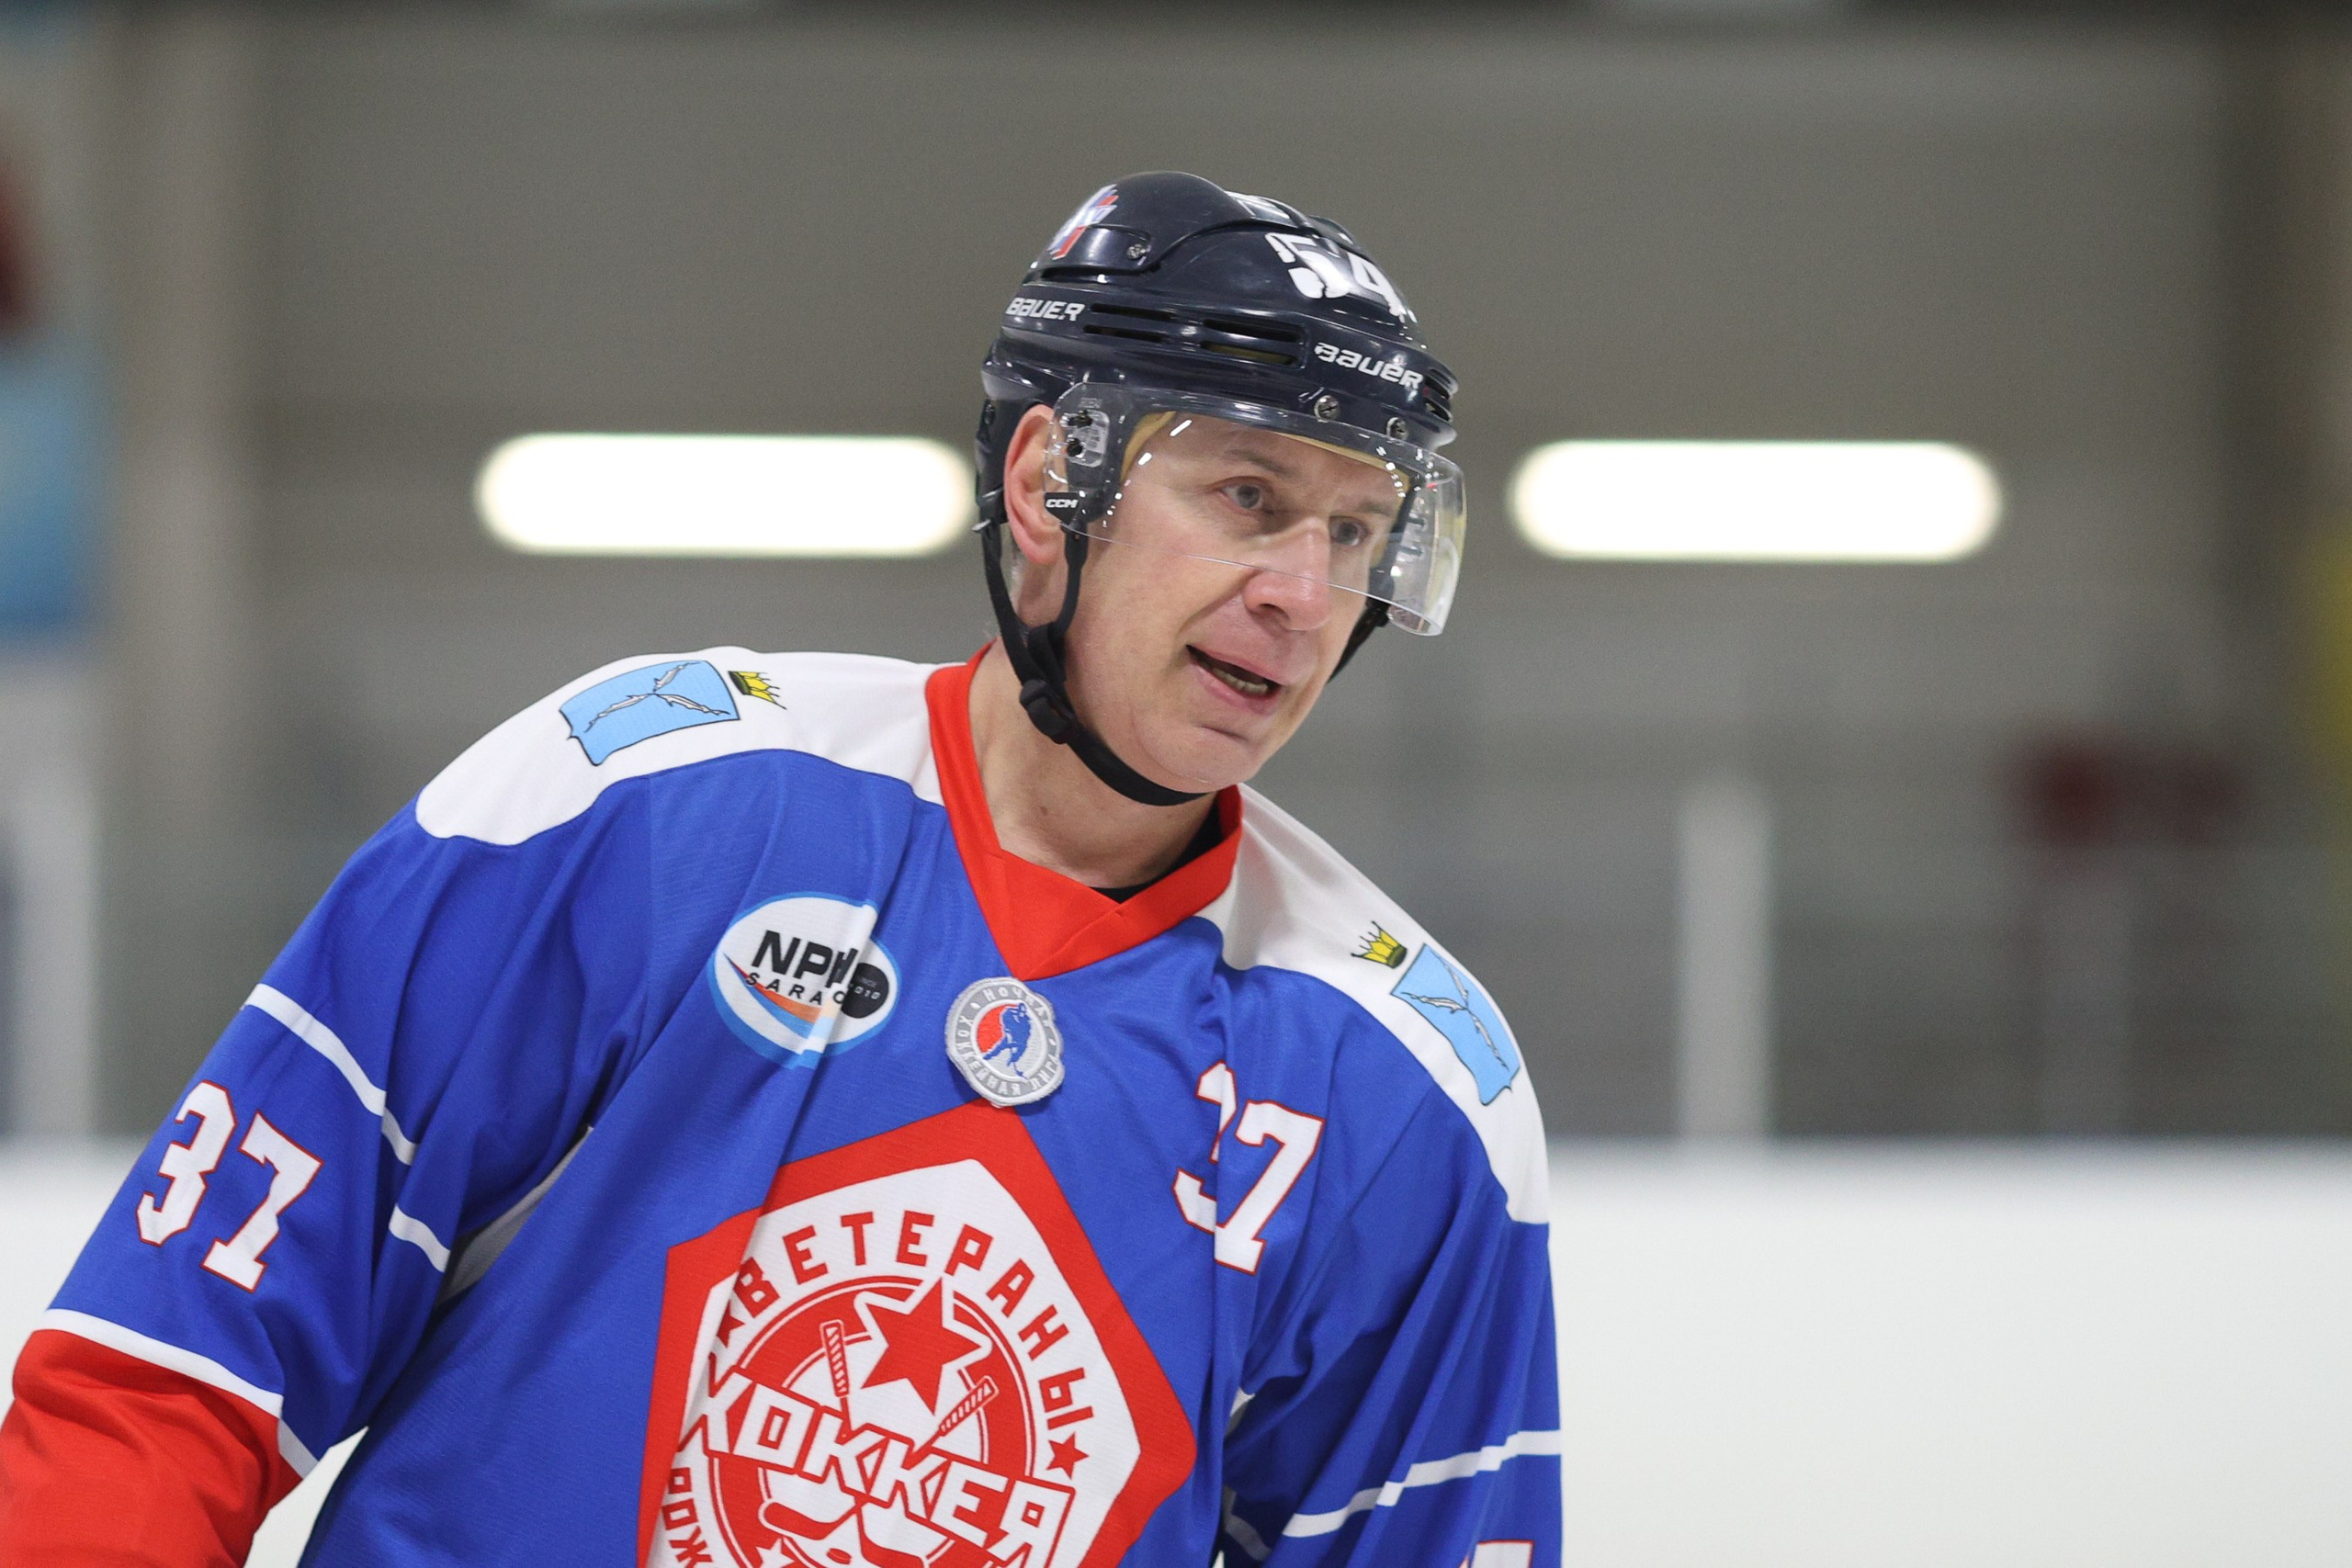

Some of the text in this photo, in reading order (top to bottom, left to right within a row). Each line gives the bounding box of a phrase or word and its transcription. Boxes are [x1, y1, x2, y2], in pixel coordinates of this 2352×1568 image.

[1005, 297, 1086, 321] BAUER
[1264, 232, 1419, 323] 54
[1045, 498, 1079, 509] CCM
[135, 1079, 325, 1294] 37
[1170, 1058, 1327, 1277] 37
[733, 1210, 1095, 1434] ВЕТЕРАНЫ
[678, 1367, 1075, 1568] ХОККЕЯ
